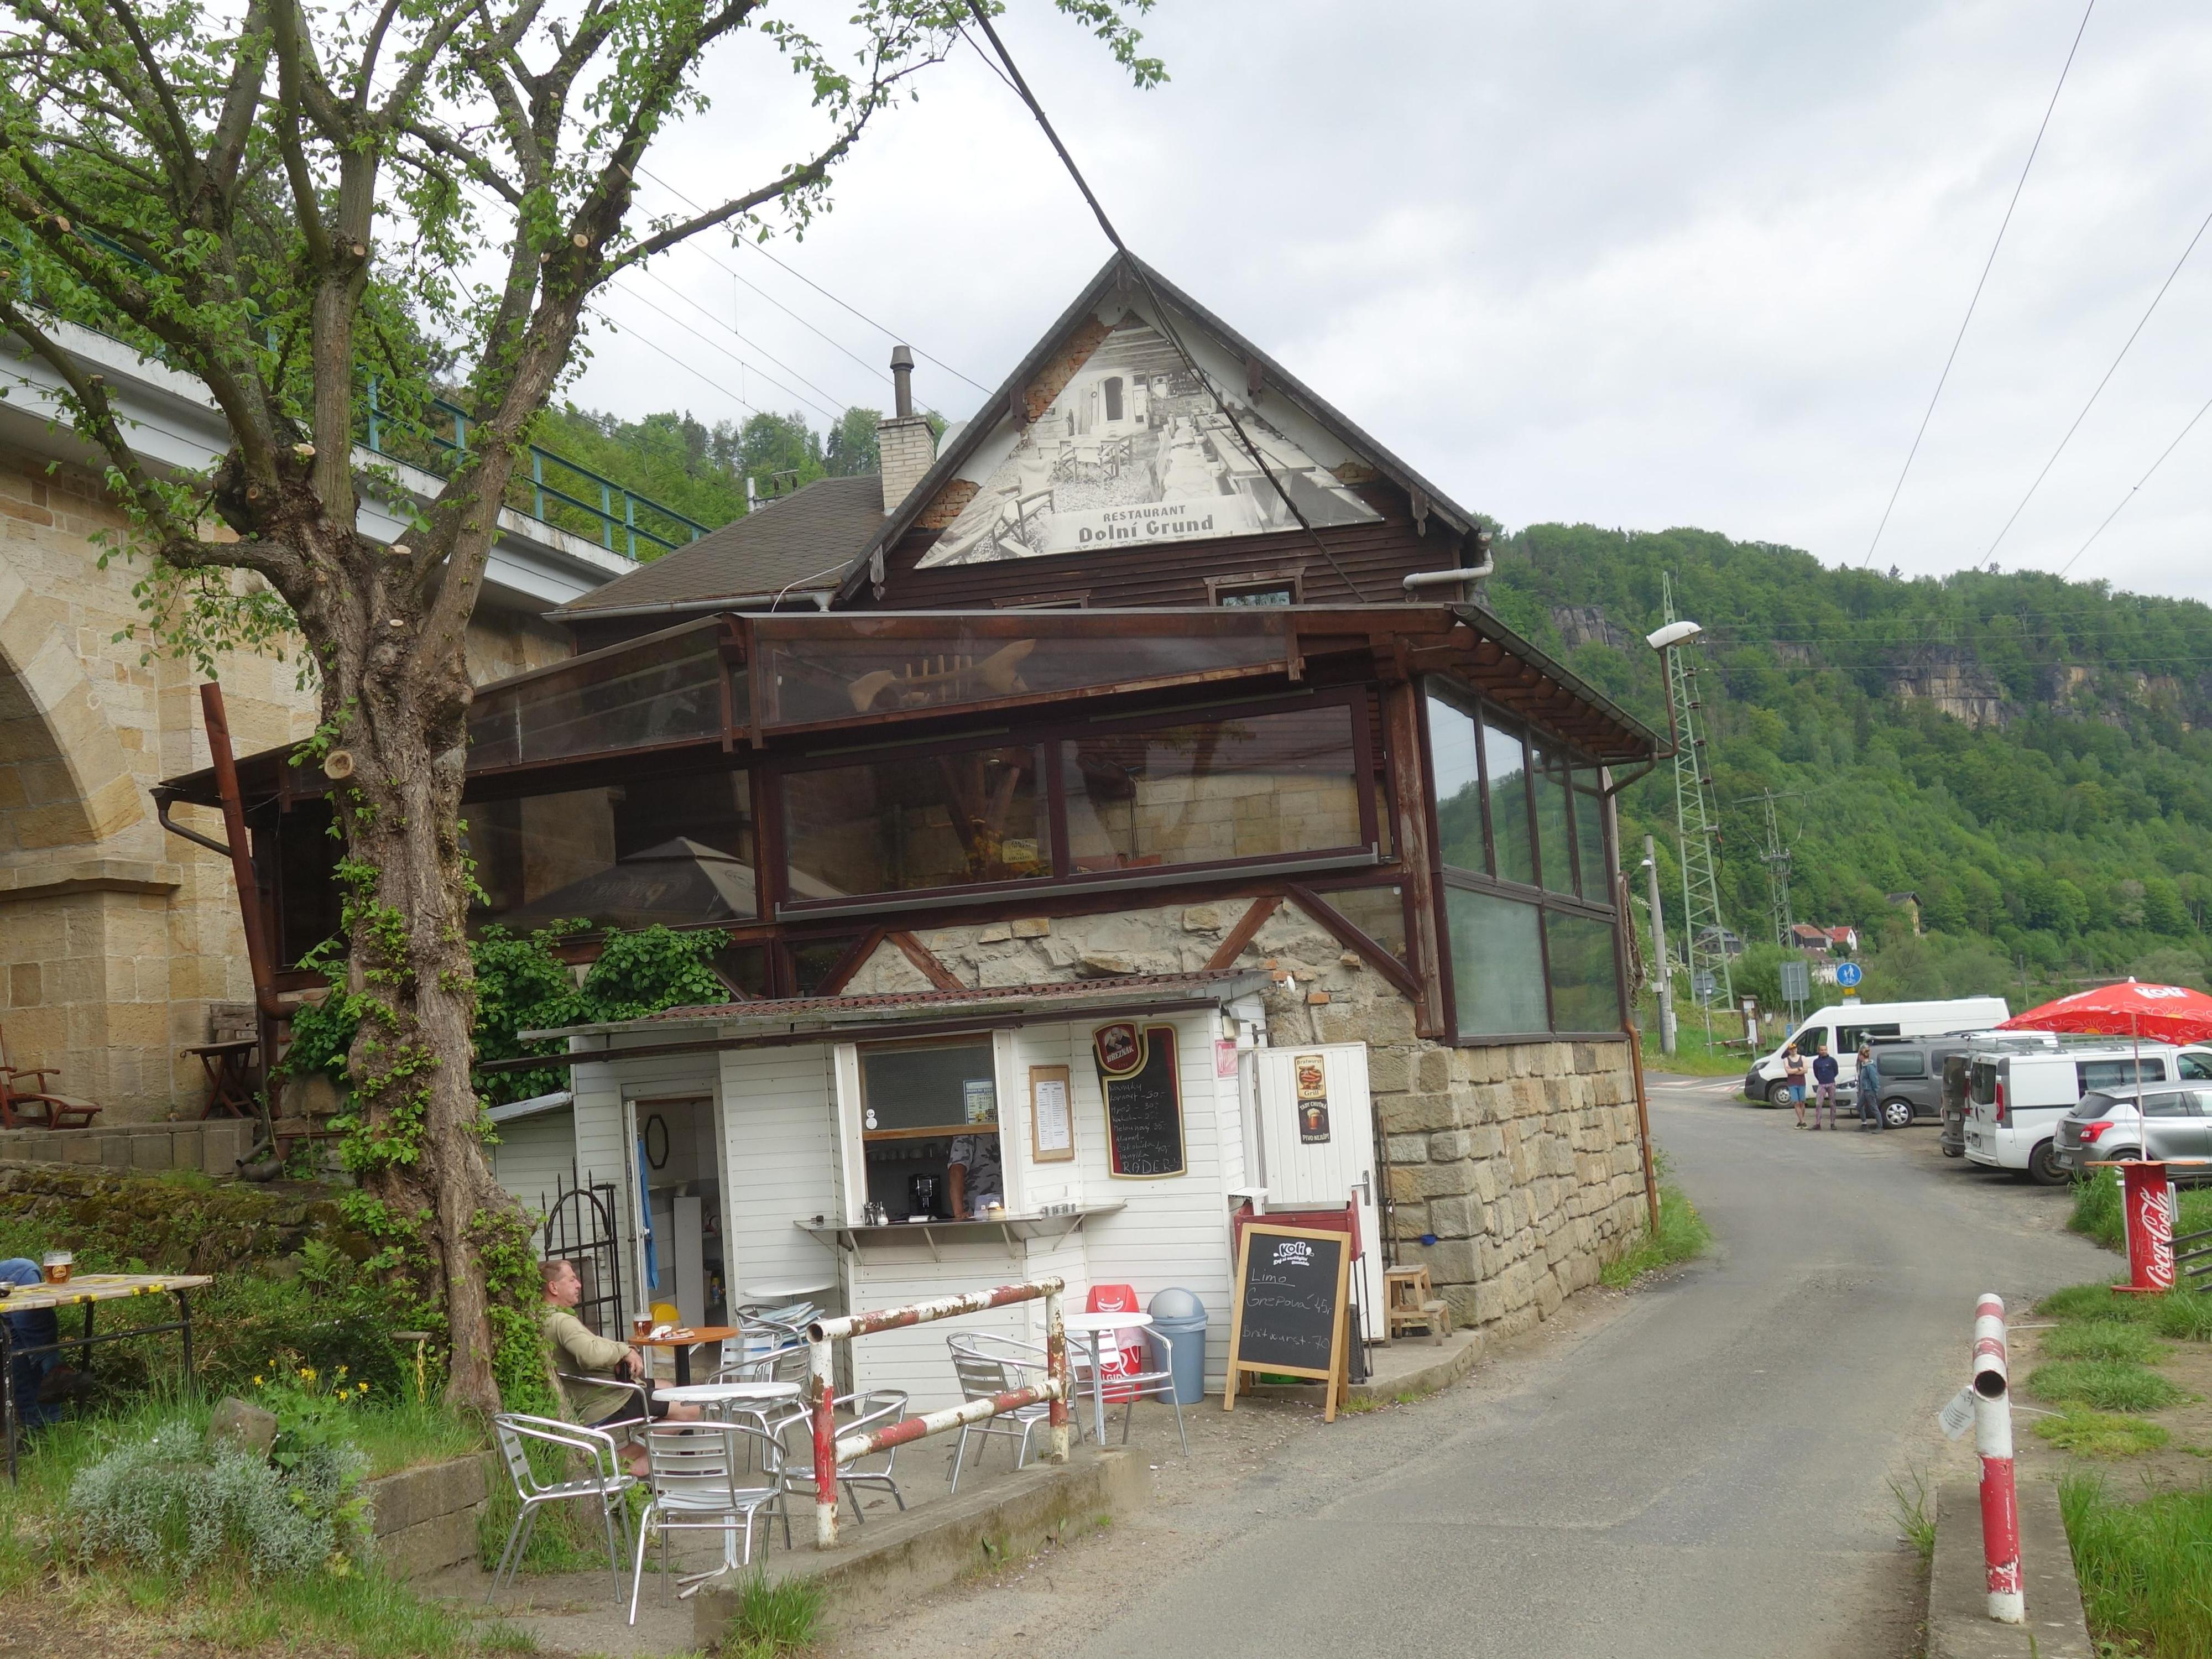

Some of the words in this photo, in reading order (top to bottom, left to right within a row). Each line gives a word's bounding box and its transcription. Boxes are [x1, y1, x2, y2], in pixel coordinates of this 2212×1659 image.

[1103, 505, 1186, 522] RESTAURANT
[1079, 522, 1137, 542] Dolní
[1146, 514, 1214, 535] Grund
[1300, 1102, 1311, 1110] TADY
[2140, 1186, 2175, 1288] Coca-Cola
[1279, 1241, 1306, 1257] Koli
[1251, 1268, 1287, 1283] Limo
